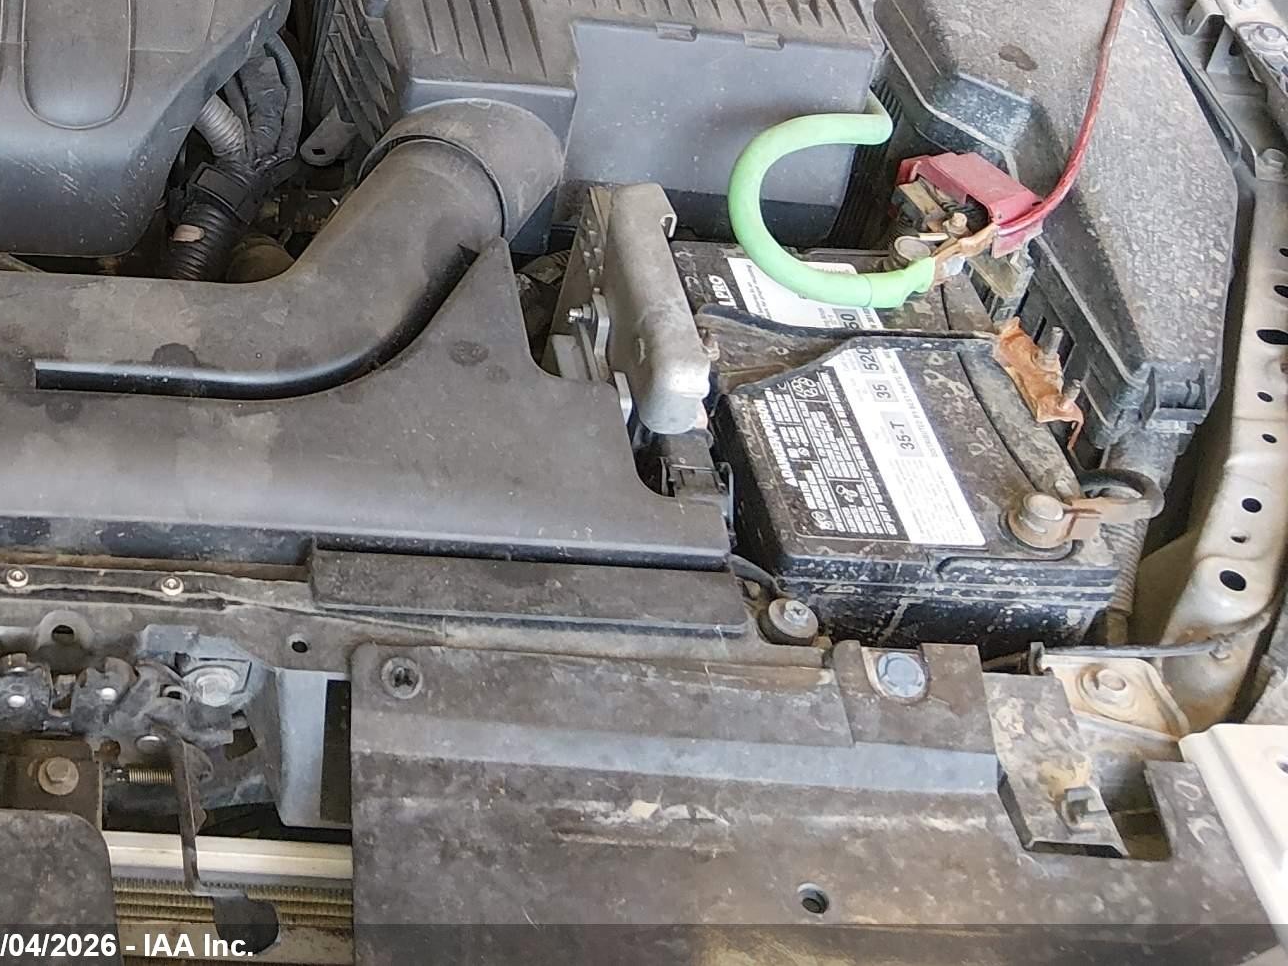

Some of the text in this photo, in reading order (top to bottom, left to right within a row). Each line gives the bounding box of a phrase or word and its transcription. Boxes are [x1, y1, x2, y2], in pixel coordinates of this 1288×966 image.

[838, 312, 861, 330] 50
[854, 346, 880, 371] 520
[870, 383, 892, 399] 35
[888, 420, 916, 450] 35-T
